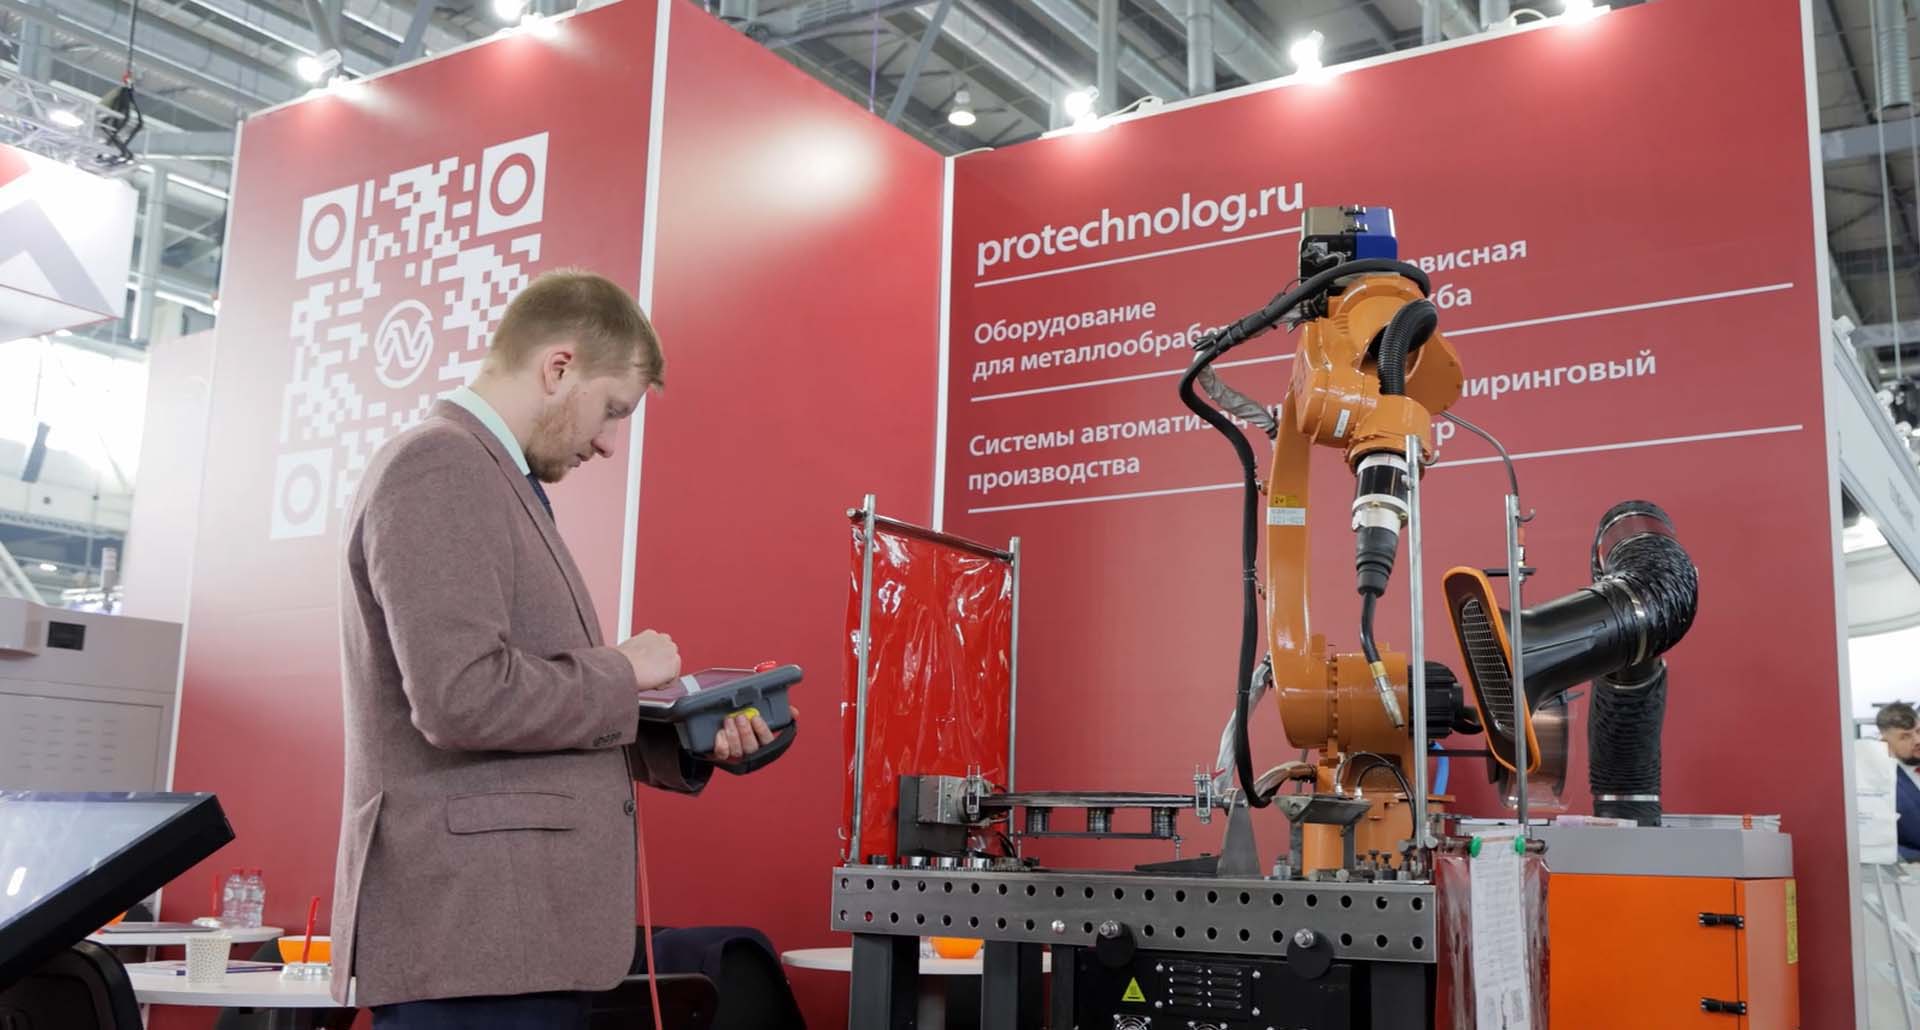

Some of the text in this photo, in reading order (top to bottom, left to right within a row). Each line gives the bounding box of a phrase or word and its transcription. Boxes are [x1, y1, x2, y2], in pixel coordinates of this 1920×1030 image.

[976, 181, 1304, 277] protechnolog.ru
[1401, 239, 1528, 274] висная
[973, 301, 1157, 345] Оборудование
[972, 322, 1230, 383] для металлообраб
[1461, 348, 1657, 401] иринговый
[968, 428, 1075, 458] Системы
[967, 456, 1140, 494] производства
